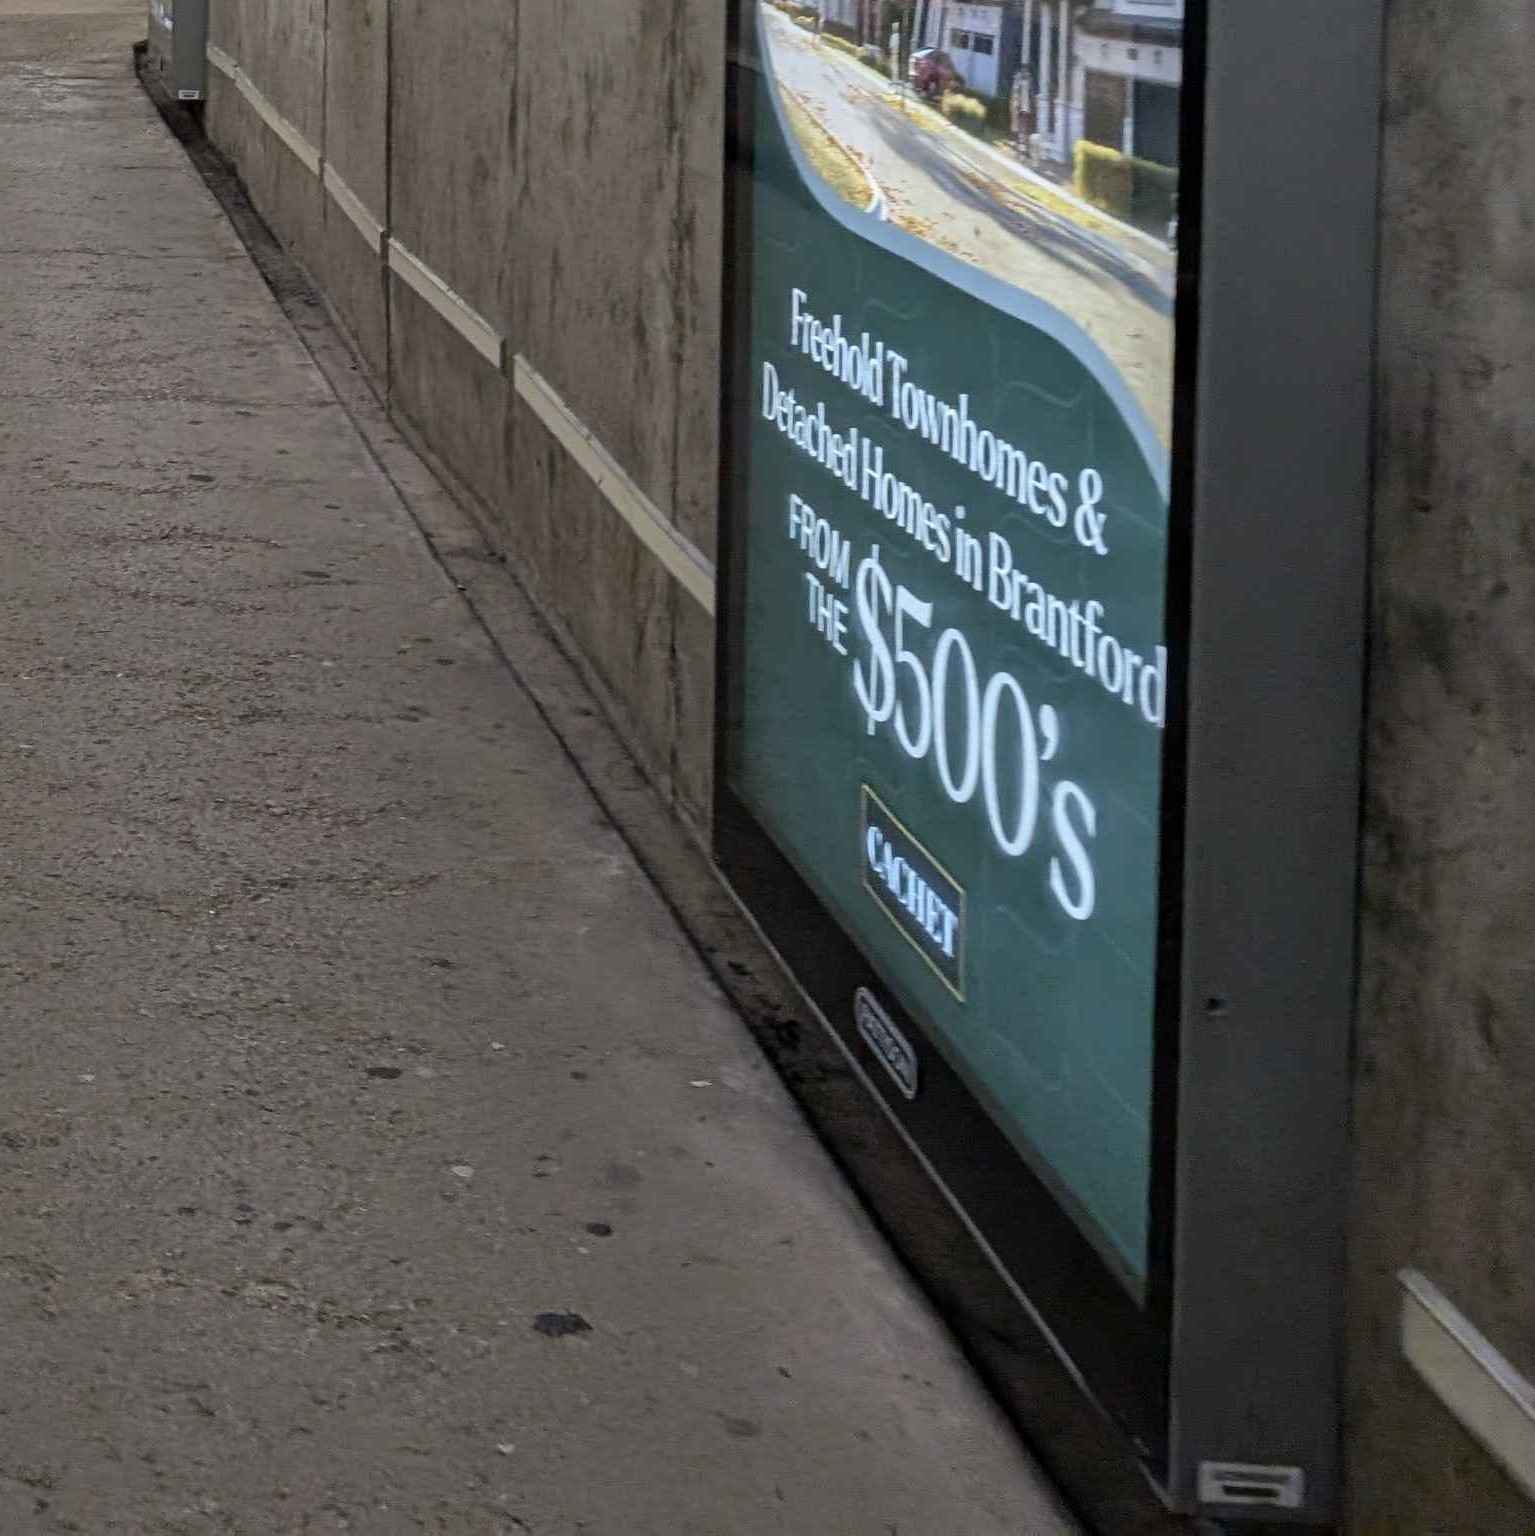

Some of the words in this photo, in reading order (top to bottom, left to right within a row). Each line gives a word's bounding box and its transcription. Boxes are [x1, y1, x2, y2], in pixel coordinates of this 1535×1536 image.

[791, 287, 883, 407] Freehold
[886, 348, 1068, 528] Townhomes
[1074, 467, 1109, 556] &
[762, 360, 858, 492] Detached
[860, 436, 951, 565] Homes
[954, 505, 983, 591] in
[988, 530, 1168, 728] Brantford
[789, 493, 851, 590] FROM
[805, 571, 849, 656] THE
[866, 825, 959, 959] CACHET
